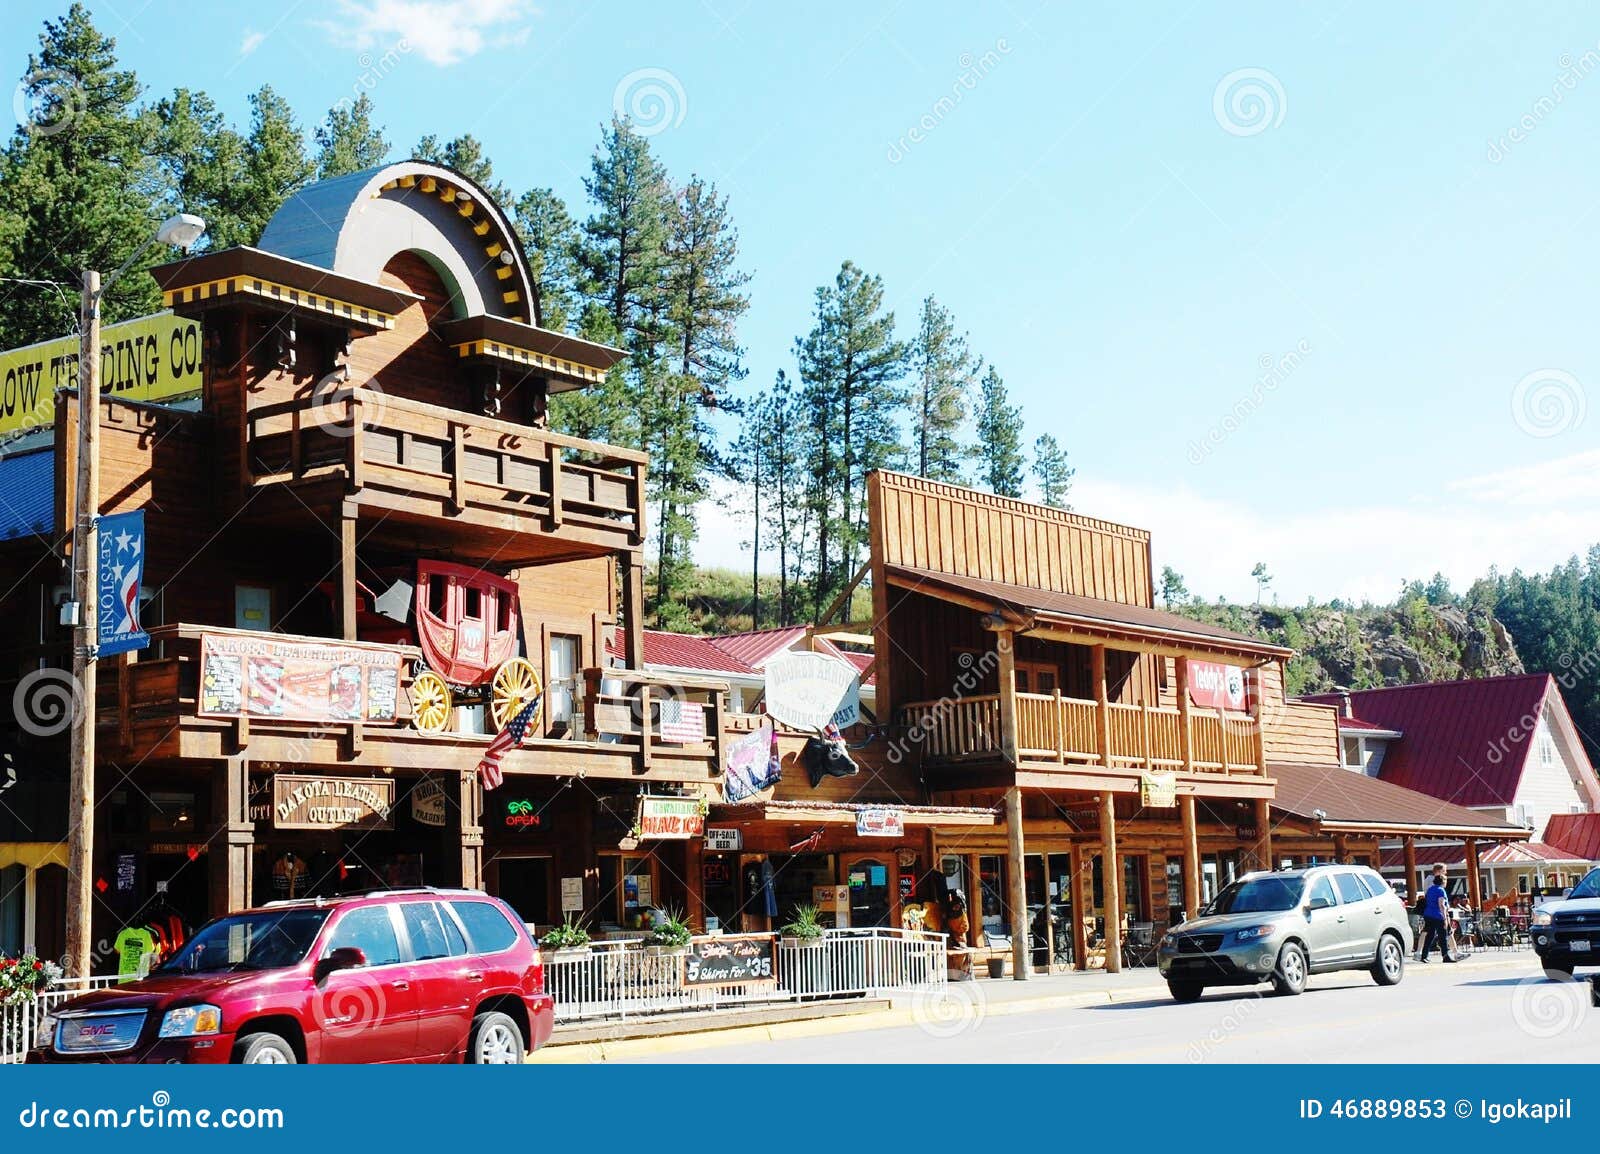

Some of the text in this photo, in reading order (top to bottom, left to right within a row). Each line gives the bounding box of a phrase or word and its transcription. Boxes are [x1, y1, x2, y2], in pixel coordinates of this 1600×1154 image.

[0, 324, 203, 419] OW TRDING CO
[100, 530, 115, 636] KEYSTONE
[1192, 664, 1225, 698] Teddy's
[277, 780, 391, 821] DAKOTA LEATHER
[308, 806, 363, 823] OUTLET
[505, 815, 540, 826] OPEN
[641, 815, 681, 834] SHAVE
[709, 830, 737, 840] OFF-SALE
[715, 840, 731, 849] BEER
[687, 957, 772, 981] 5 Shirts For $35
[79, 1024, 116, 1036] GMC
